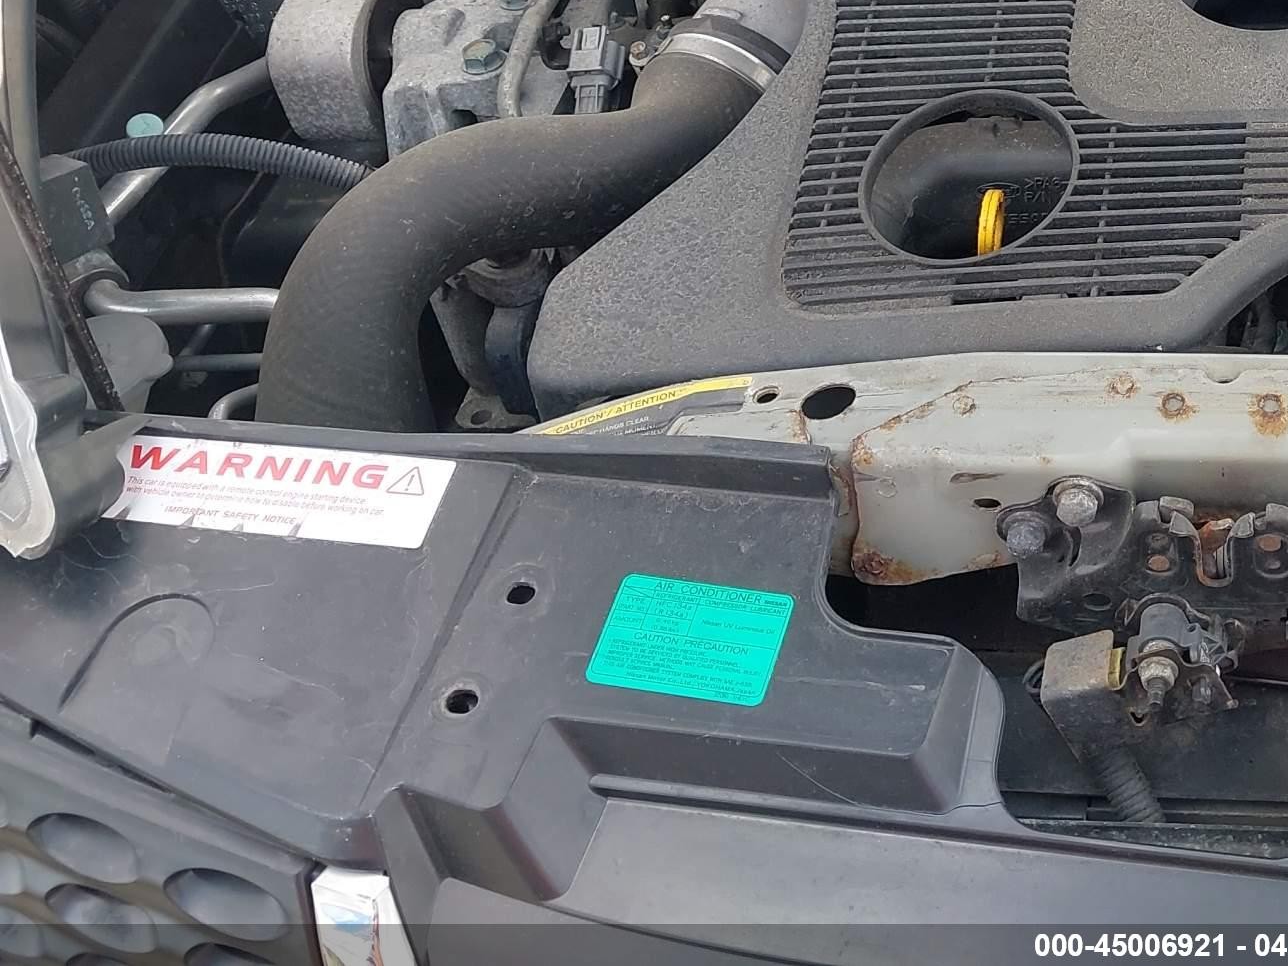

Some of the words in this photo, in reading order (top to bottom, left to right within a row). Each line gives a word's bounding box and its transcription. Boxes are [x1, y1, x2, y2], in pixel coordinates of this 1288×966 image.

[554, 412, 603, 434] CAUTION
[614, 390, 677, 414] ATTENTION
[130, 445, 389, 490] WARNING
[164, 505, 219, 517] IMPORTANT
[223, 510, 259, 522] SAFETY
[263, 515, 297, 525] NOTICE
[655, 581, 675, 592] AIR
[681, 585, 762, 604] CONDITIONER
[634, 631, 679, 646] CAUTION
[684, 639, 749, 656] PRECAUTION
